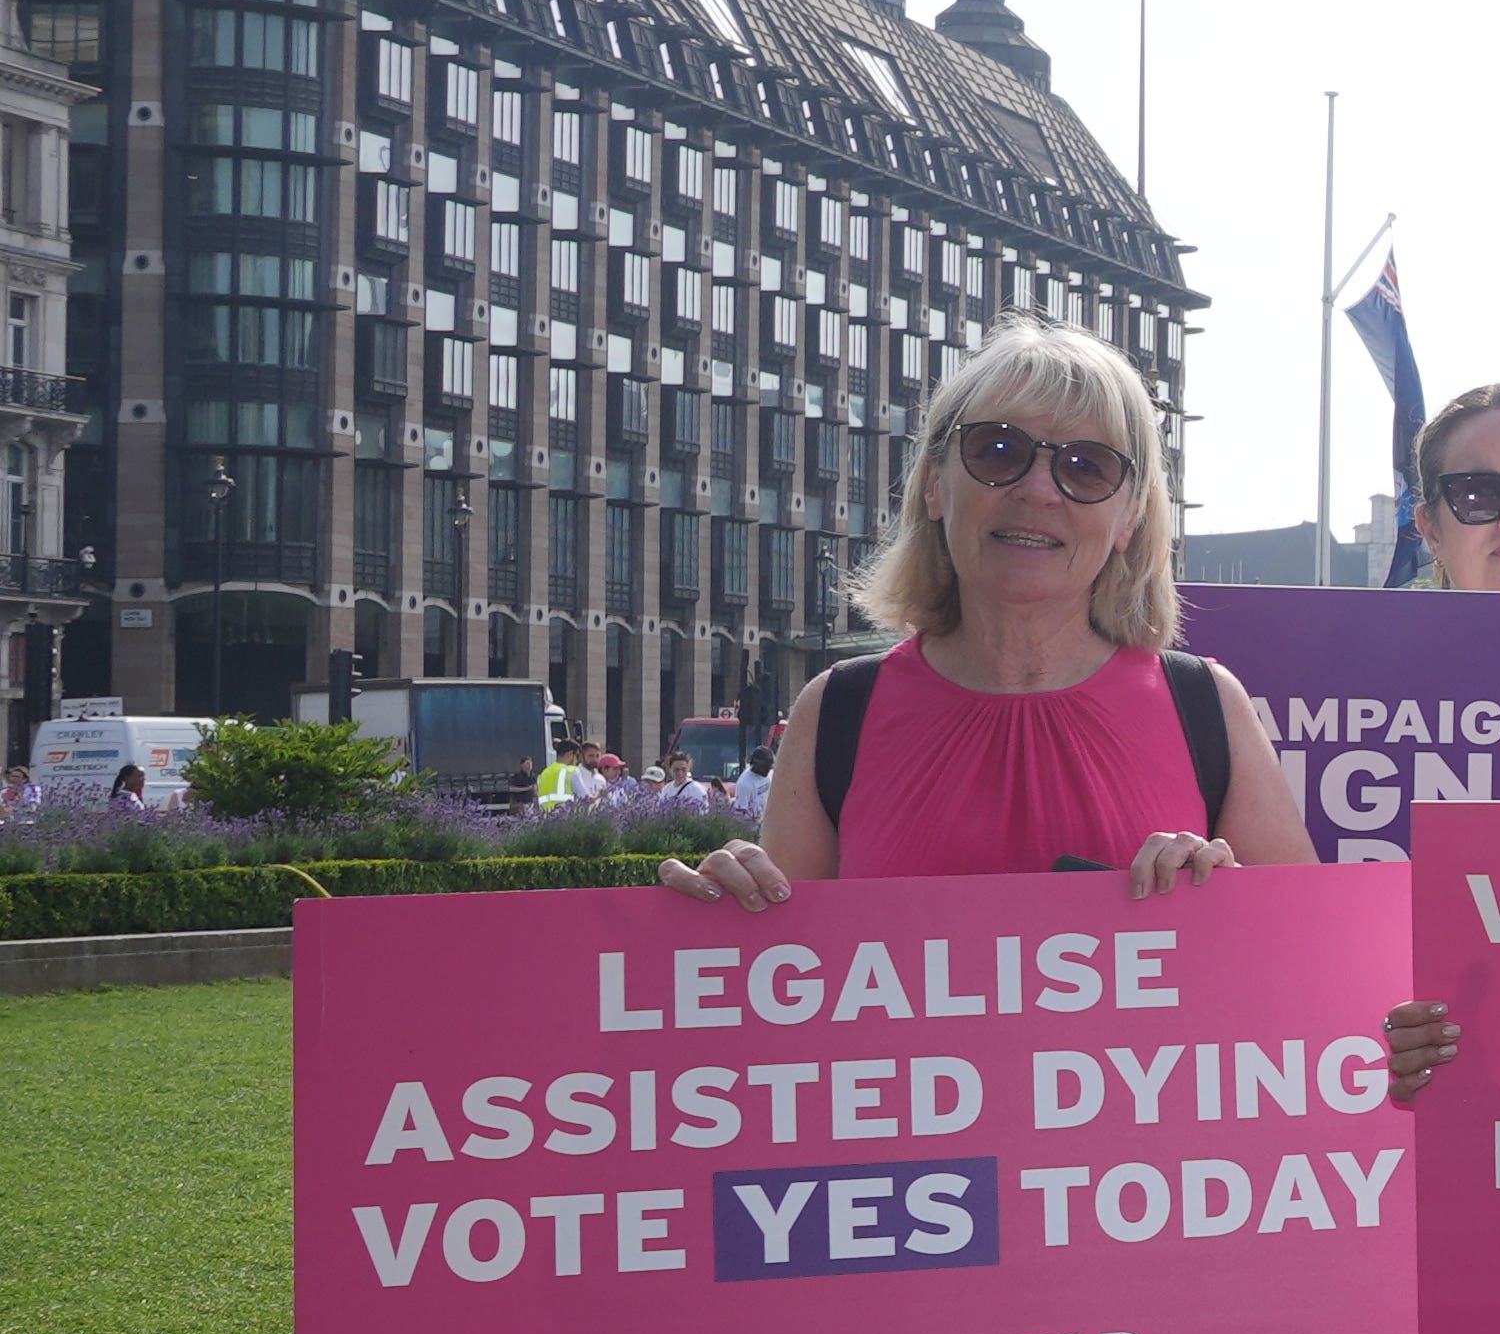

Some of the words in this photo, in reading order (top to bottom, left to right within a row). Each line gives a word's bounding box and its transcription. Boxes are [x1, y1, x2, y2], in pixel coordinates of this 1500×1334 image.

[600, 931, 1179, 1031] LEGALISE
[365, 1057, 983, 1165] ASSISTED
[1033, 1036, 1389, 1129] DYING
[352, 1189, 686, 1286] VOTE
[733, 1173, 973, 1263] YES
[1021, 1149, 1405, 1246] TODAY
